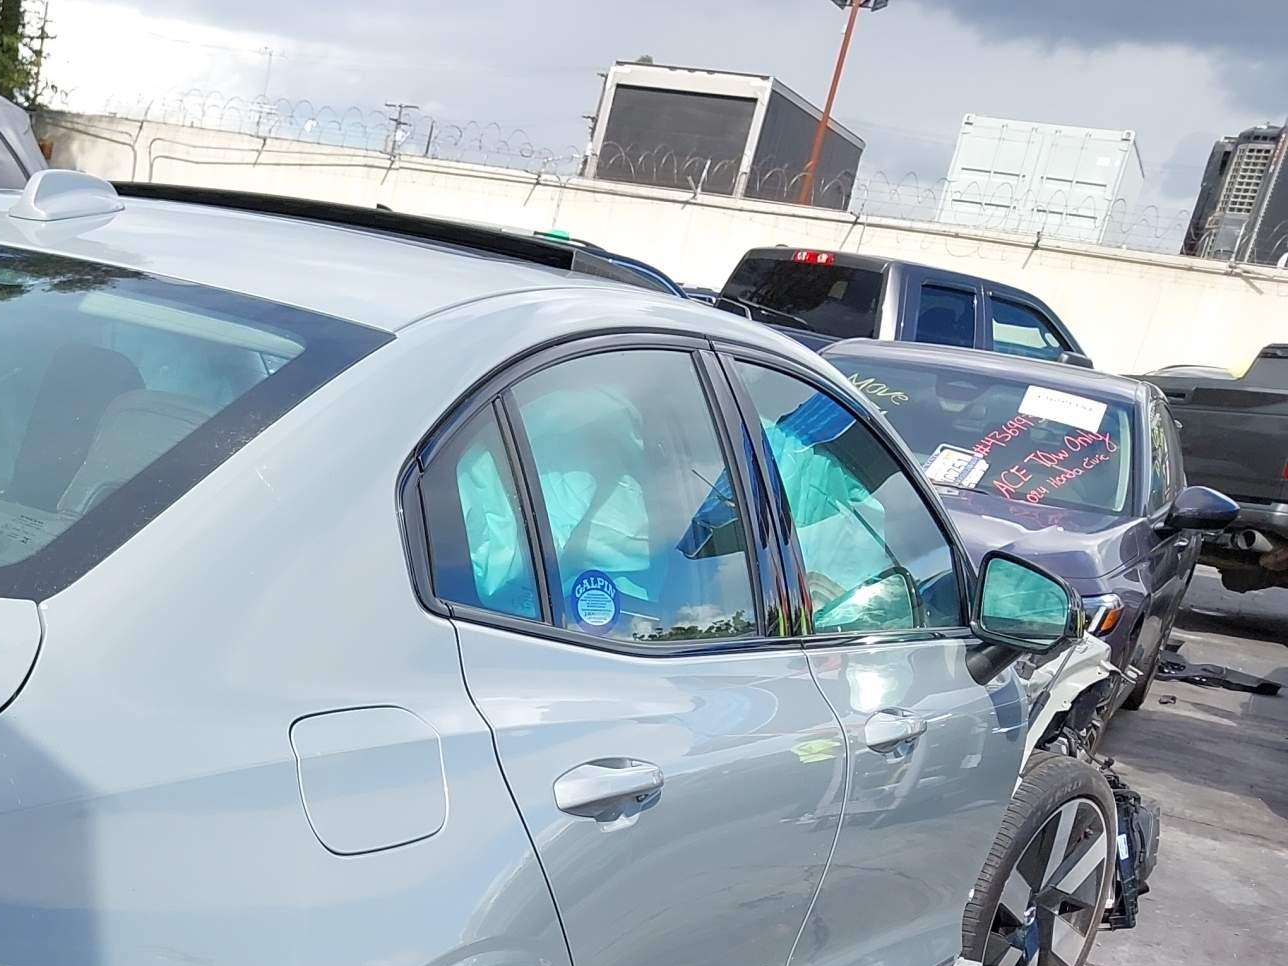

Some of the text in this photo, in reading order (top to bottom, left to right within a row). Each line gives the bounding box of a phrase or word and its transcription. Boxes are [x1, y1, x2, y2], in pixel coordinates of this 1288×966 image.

[972, 413, 1048, 456] #43699
[992, 465, 1032, 499] ACE
[575, 576, 616, 599] GALPIN
